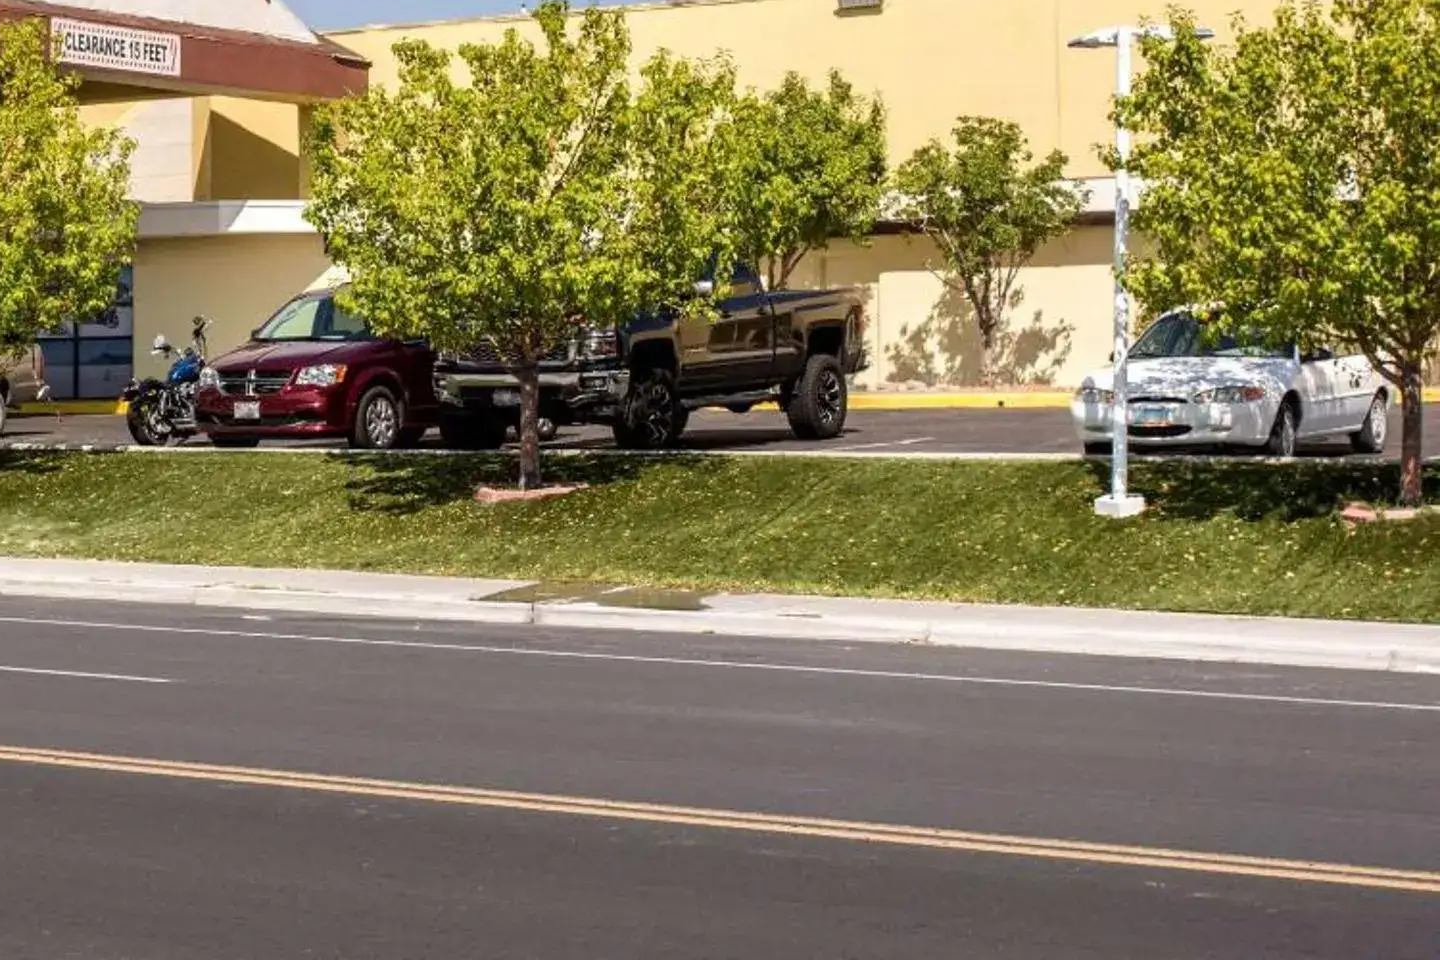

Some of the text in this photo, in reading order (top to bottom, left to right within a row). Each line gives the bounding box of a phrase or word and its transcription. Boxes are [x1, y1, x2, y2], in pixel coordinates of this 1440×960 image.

[64, 32, 168, 63] CLEARANCE 15 FEET
